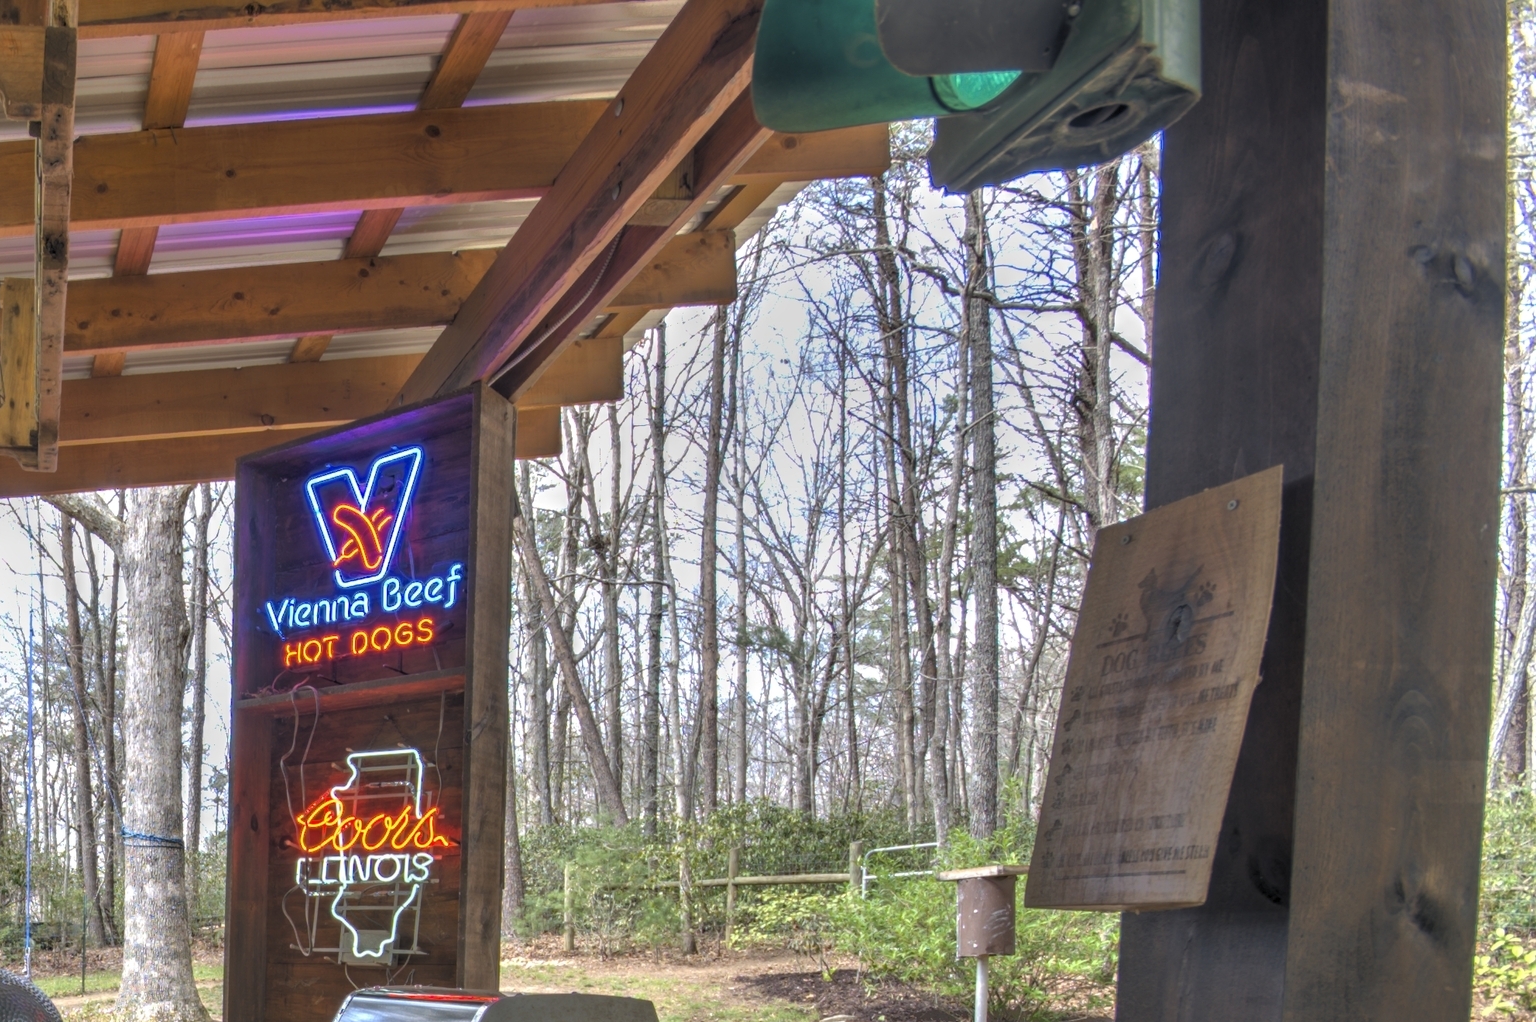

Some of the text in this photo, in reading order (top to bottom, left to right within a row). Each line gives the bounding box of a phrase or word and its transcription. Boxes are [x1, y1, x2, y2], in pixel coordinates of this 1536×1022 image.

[266, 564, 463, 632] Vienna Beef
[285, 617, 435, 667] HOT DOGS
[1100, 649, 1139, 677] DOG
[297, 798, 449, 853] Coors
